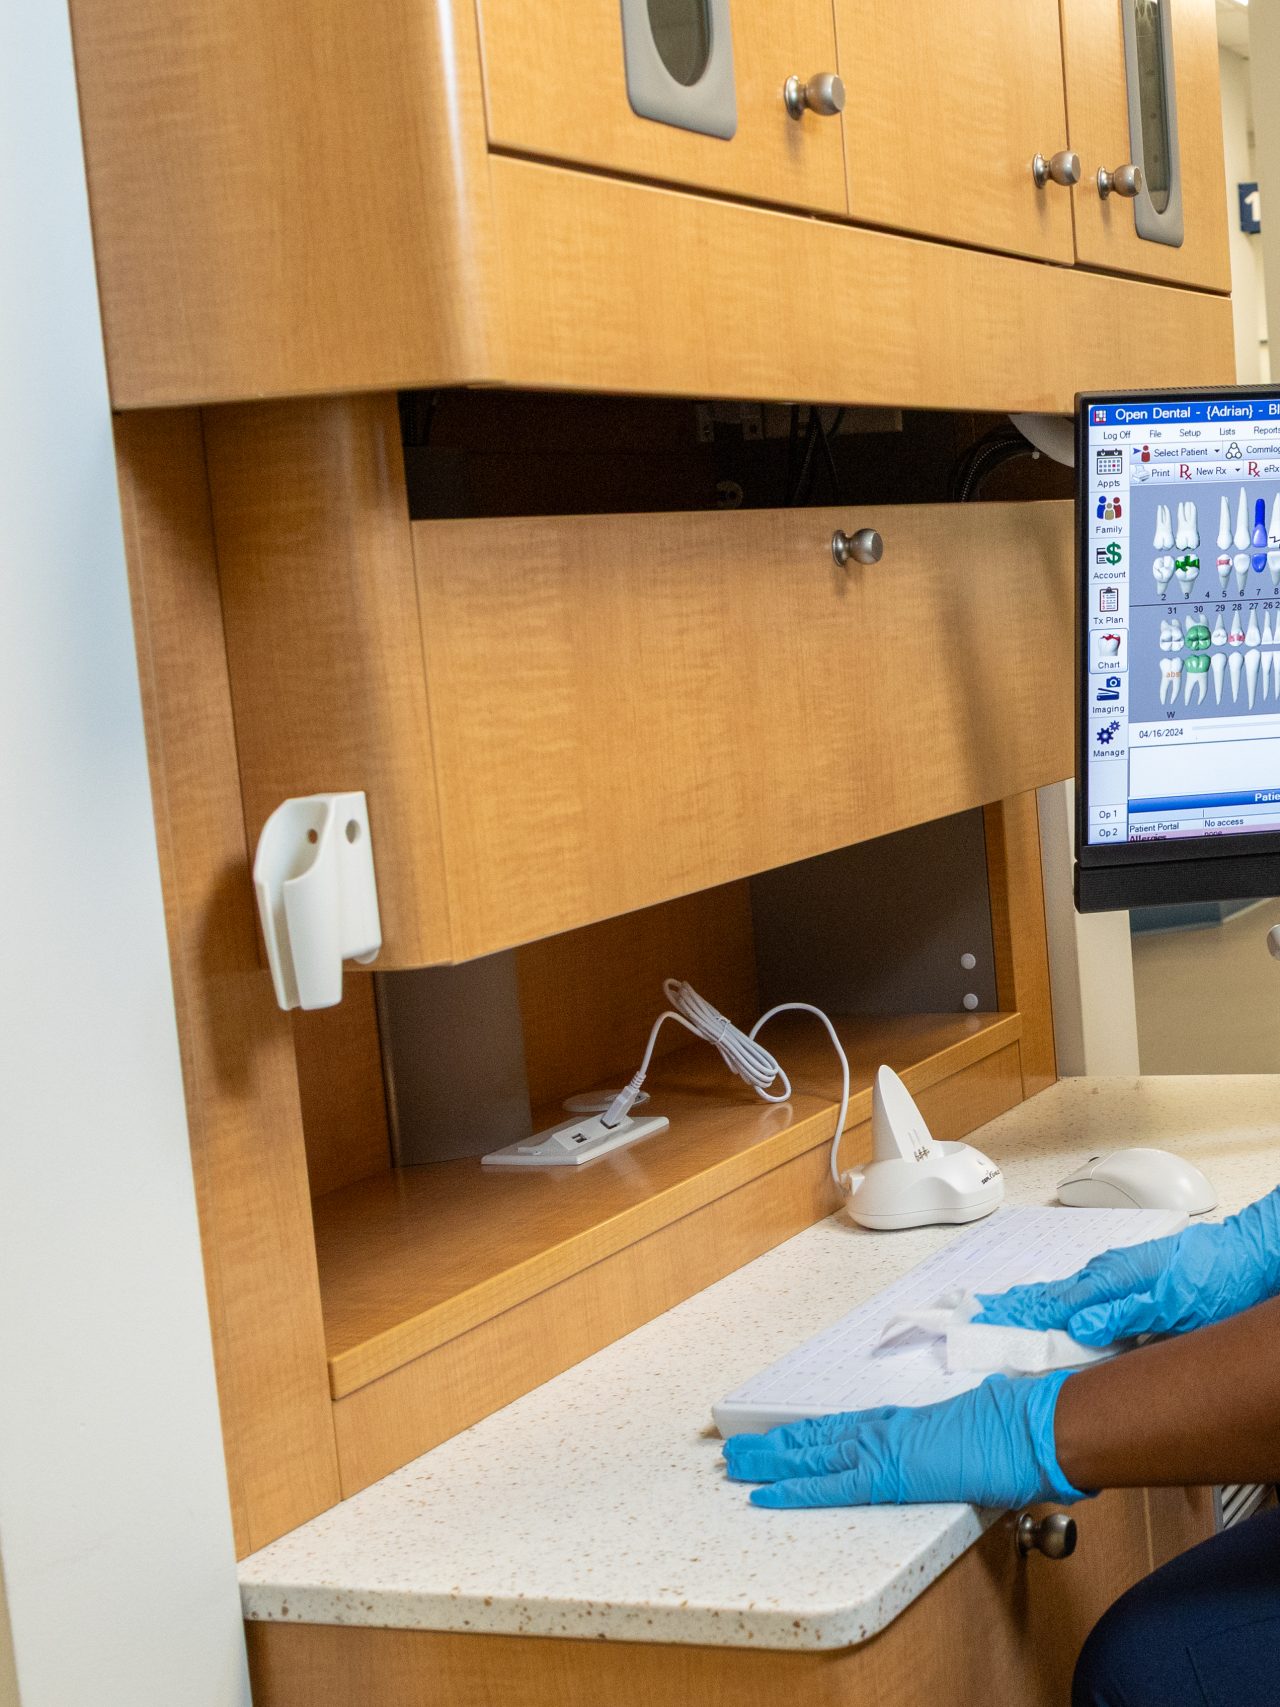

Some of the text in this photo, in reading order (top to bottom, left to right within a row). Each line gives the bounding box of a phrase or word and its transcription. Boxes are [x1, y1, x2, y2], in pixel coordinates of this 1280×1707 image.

[1115, 408, 1148, 423] Open
[1152, 407, 1191, 419] Dental
[1206, 405, 1254, 420] {Adrian}
[1103, 430, 1132, 441] Log Off
[1150, 430, 1162, 438] File
[1179, 429, 1201, 438] Setup
[1219, 428, 1236, 436] Lists
[1154, 448, 1208, 458] Select Patient
[1151, 469, 1170, 478] Print
[1196, 467, 1227, 476] New Rx
[1264, 465, 1280, 473] eRx
[1097, 480, 1120, 488] Appts
[1095, 526, 1123, 535] Family
[1093, 571, 1126, 580] Account
[1184, 592, 1190, 600] 3
[1222, 590, 1227, 598] 5
[1239, 589, 1245, 597] 6
[1167, 607, 1177, 615] 31
[1215, 604, 1226, 612] 29
[1232, 603, 1242, 611] 28
[1093, 616, 1124, 625] Tx Plan
[1098, 661, 1120, 670] Chart
[1092, 705, 1125, 716] Imaging
[1138, 728, 1184, 739] 04/16/2024
[1093, 748, 1125, 758] Manage
[1099, 810, 1112, 820] Op
[1129, 822, 1180, 833] Patient Portal
[1204, 818, 1244, 828] No access
[1099, 828, 1118, 838] Op 2
